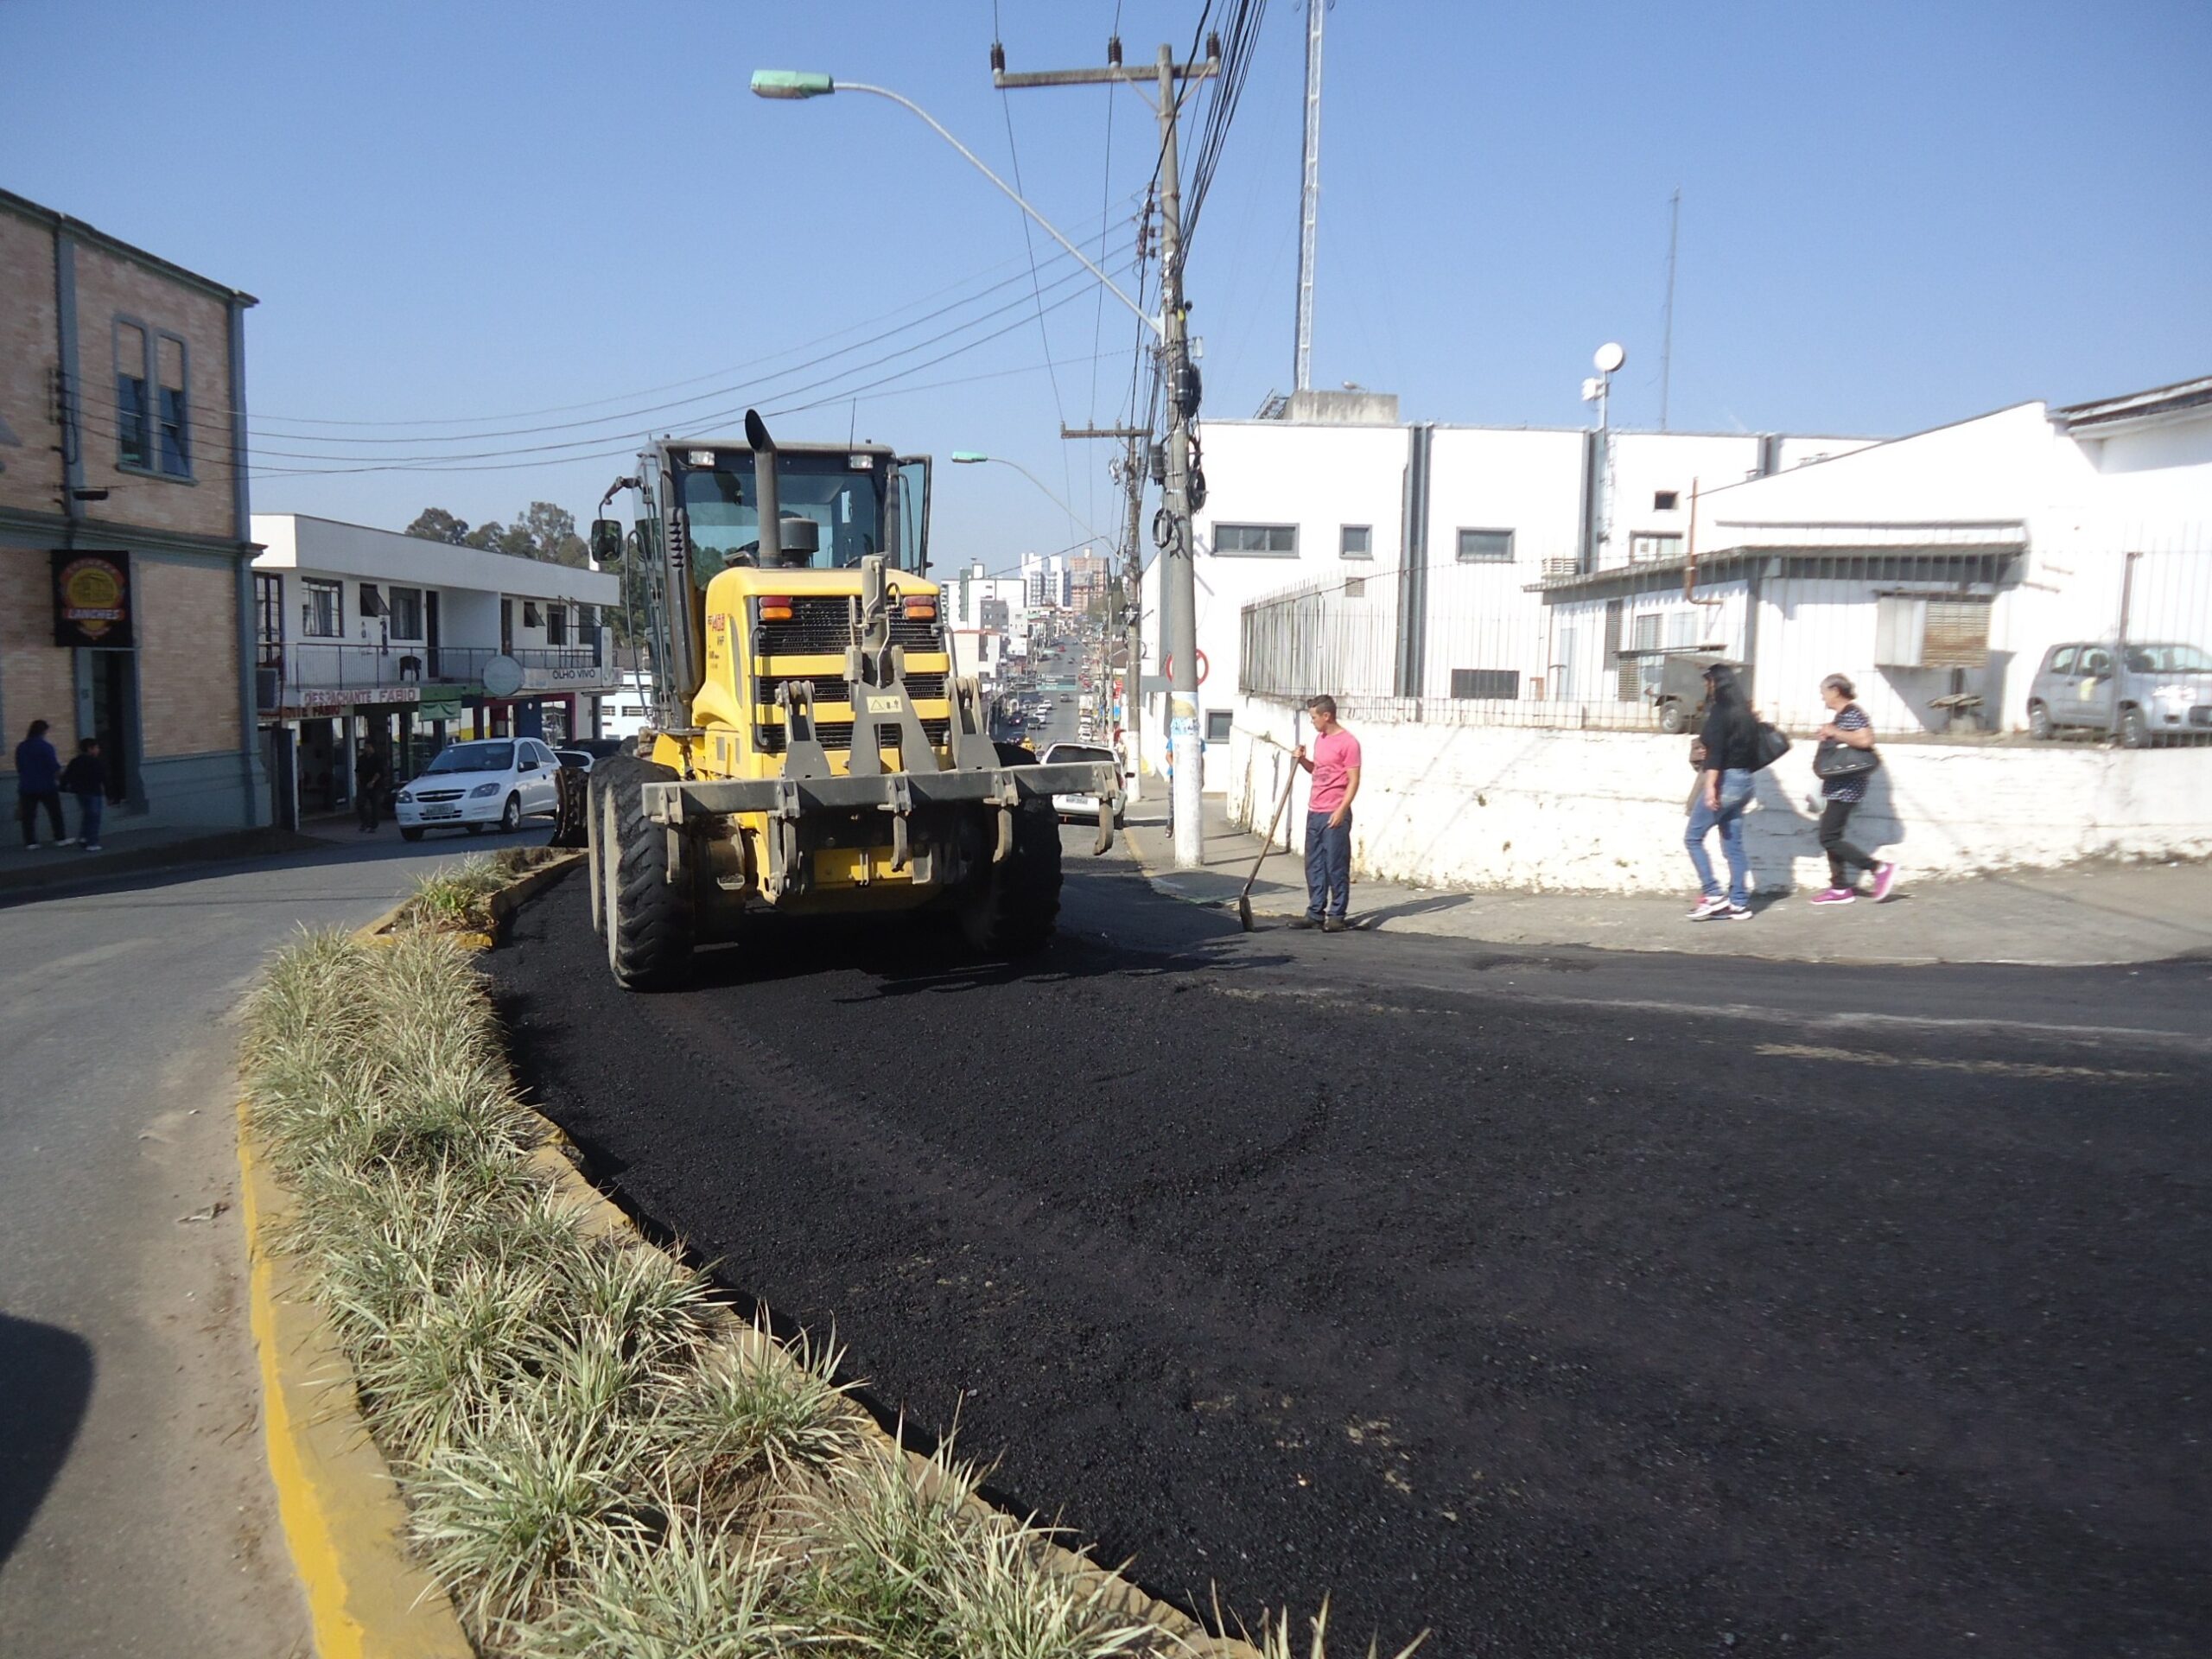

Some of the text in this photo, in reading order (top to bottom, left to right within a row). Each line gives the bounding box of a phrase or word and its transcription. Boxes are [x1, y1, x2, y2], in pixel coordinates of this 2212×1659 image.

[552, 669, 595, 679] OLHO VIVO
[304, 690, 416, 705] DESPACHANTE FABIO
